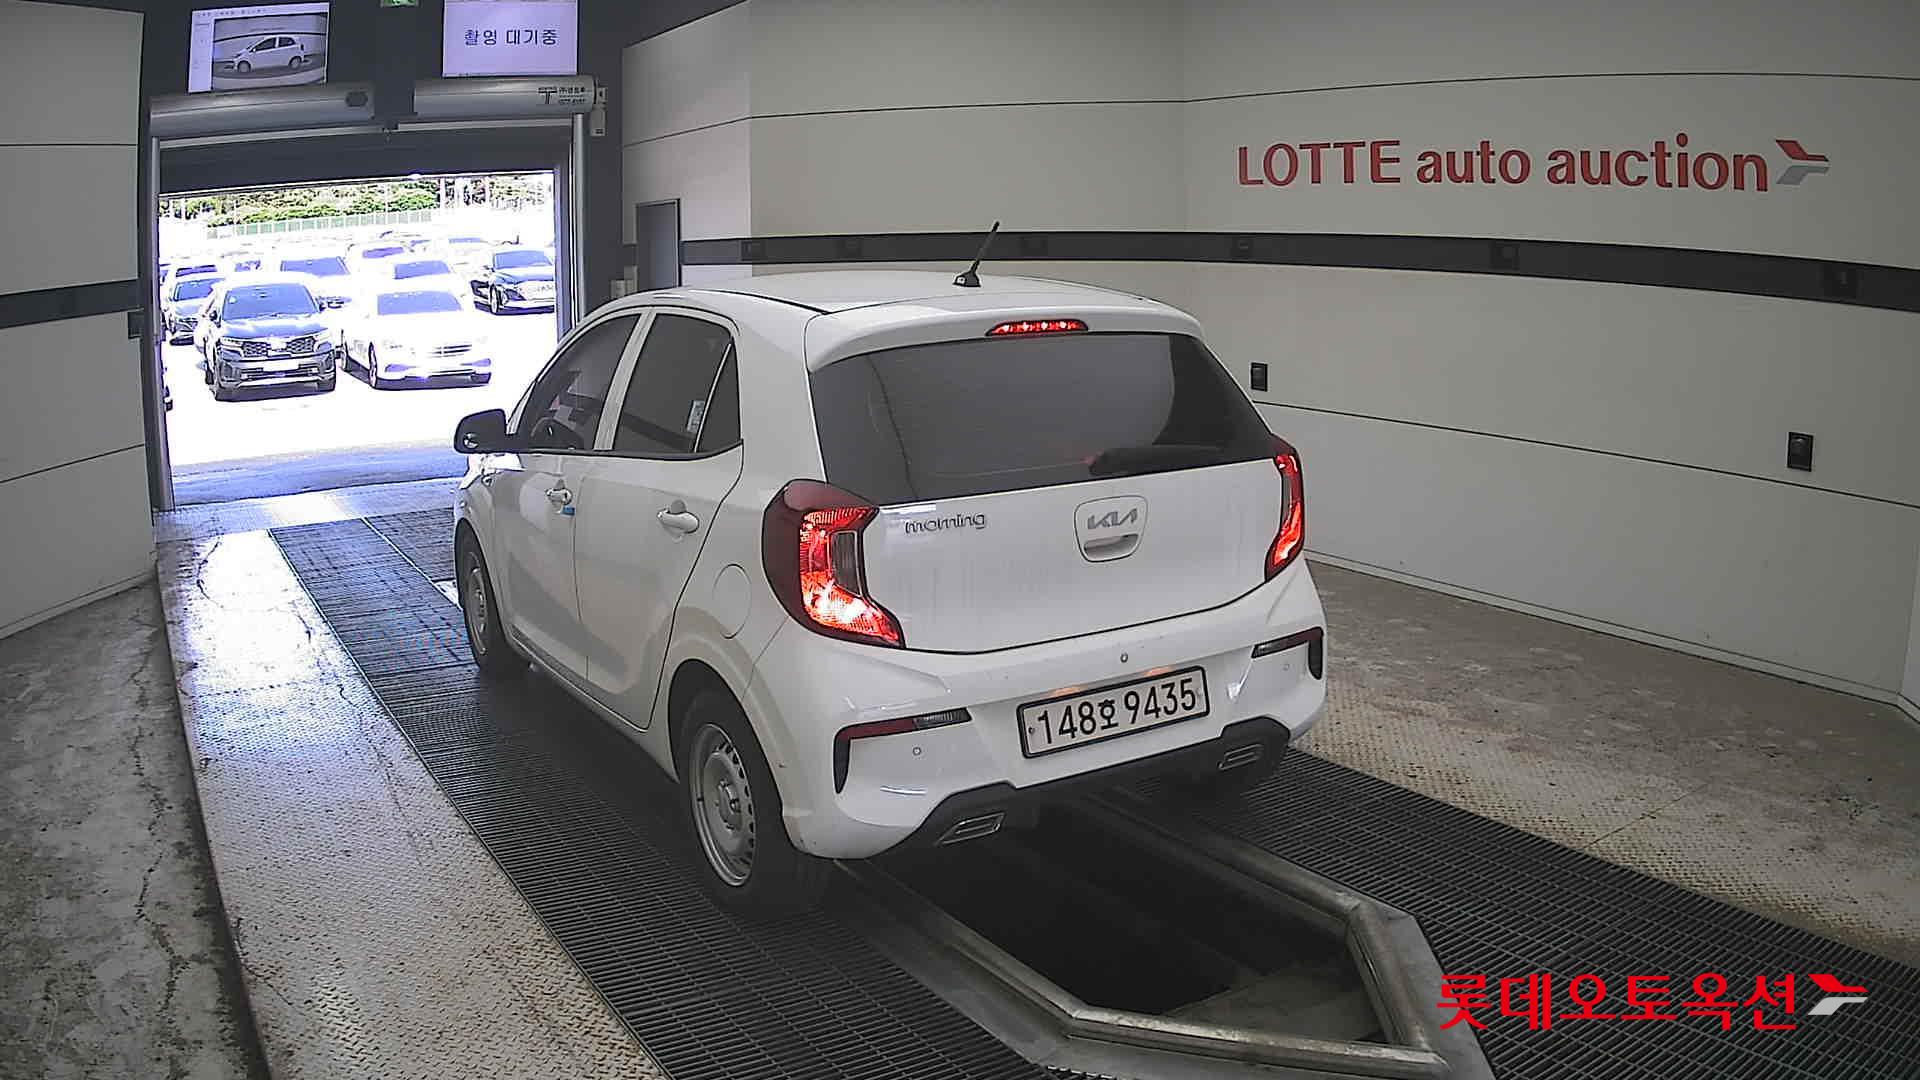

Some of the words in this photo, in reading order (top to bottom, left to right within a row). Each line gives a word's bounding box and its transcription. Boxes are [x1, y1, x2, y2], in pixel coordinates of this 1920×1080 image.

[464, 29, 497, 46] 촬영
[505, 29, 558, 46] 대기중
[1238, 139, 1401, 187] LOTTE
[1415, 140, 1531, 185] auto
[1546, 132, 1769, 192] auction
[905, 514, 985, 534] morning
[1123, 676, 1197, 726] 9435
